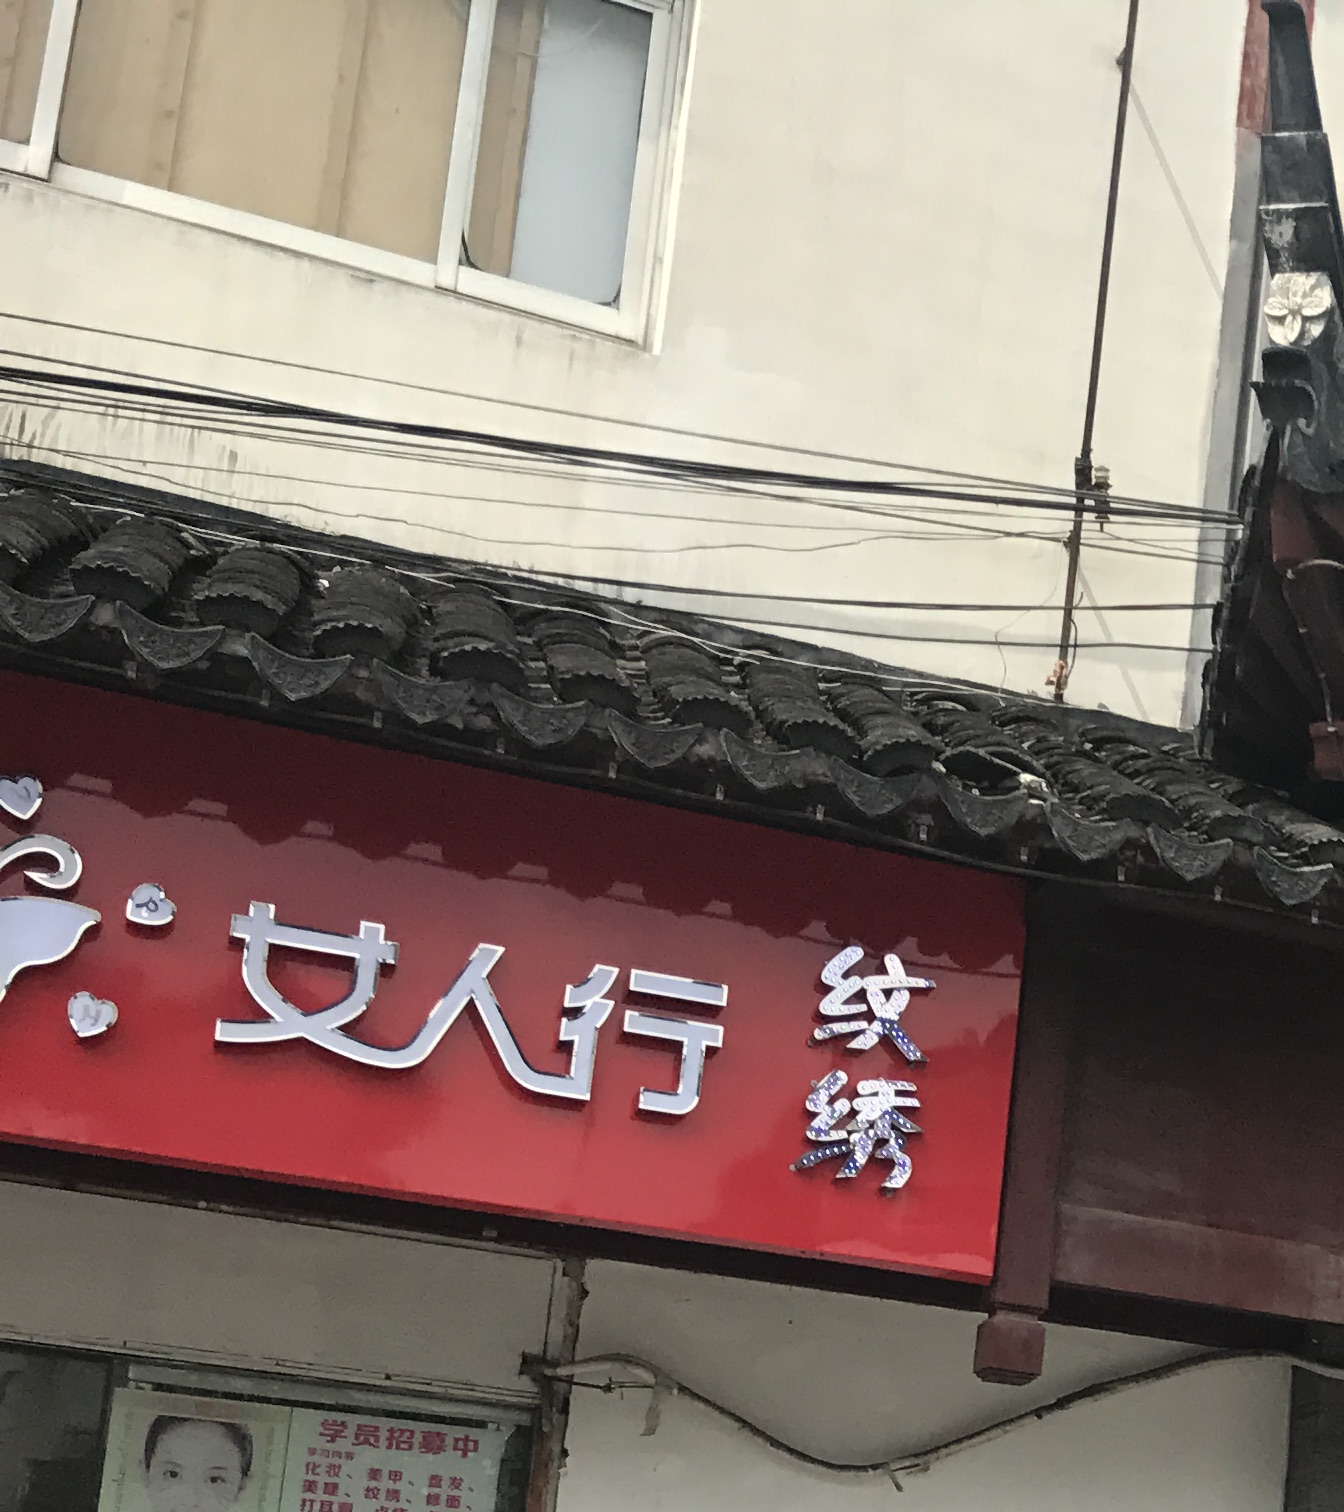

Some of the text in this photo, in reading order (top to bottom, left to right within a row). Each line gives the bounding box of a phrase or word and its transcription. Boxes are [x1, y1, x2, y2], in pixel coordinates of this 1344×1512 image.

[214, 901, 729, 1117] 女人行
[789, 946, 936, 1194] 纹绣
[319, 1418, 479, 1458] 学员招募中
